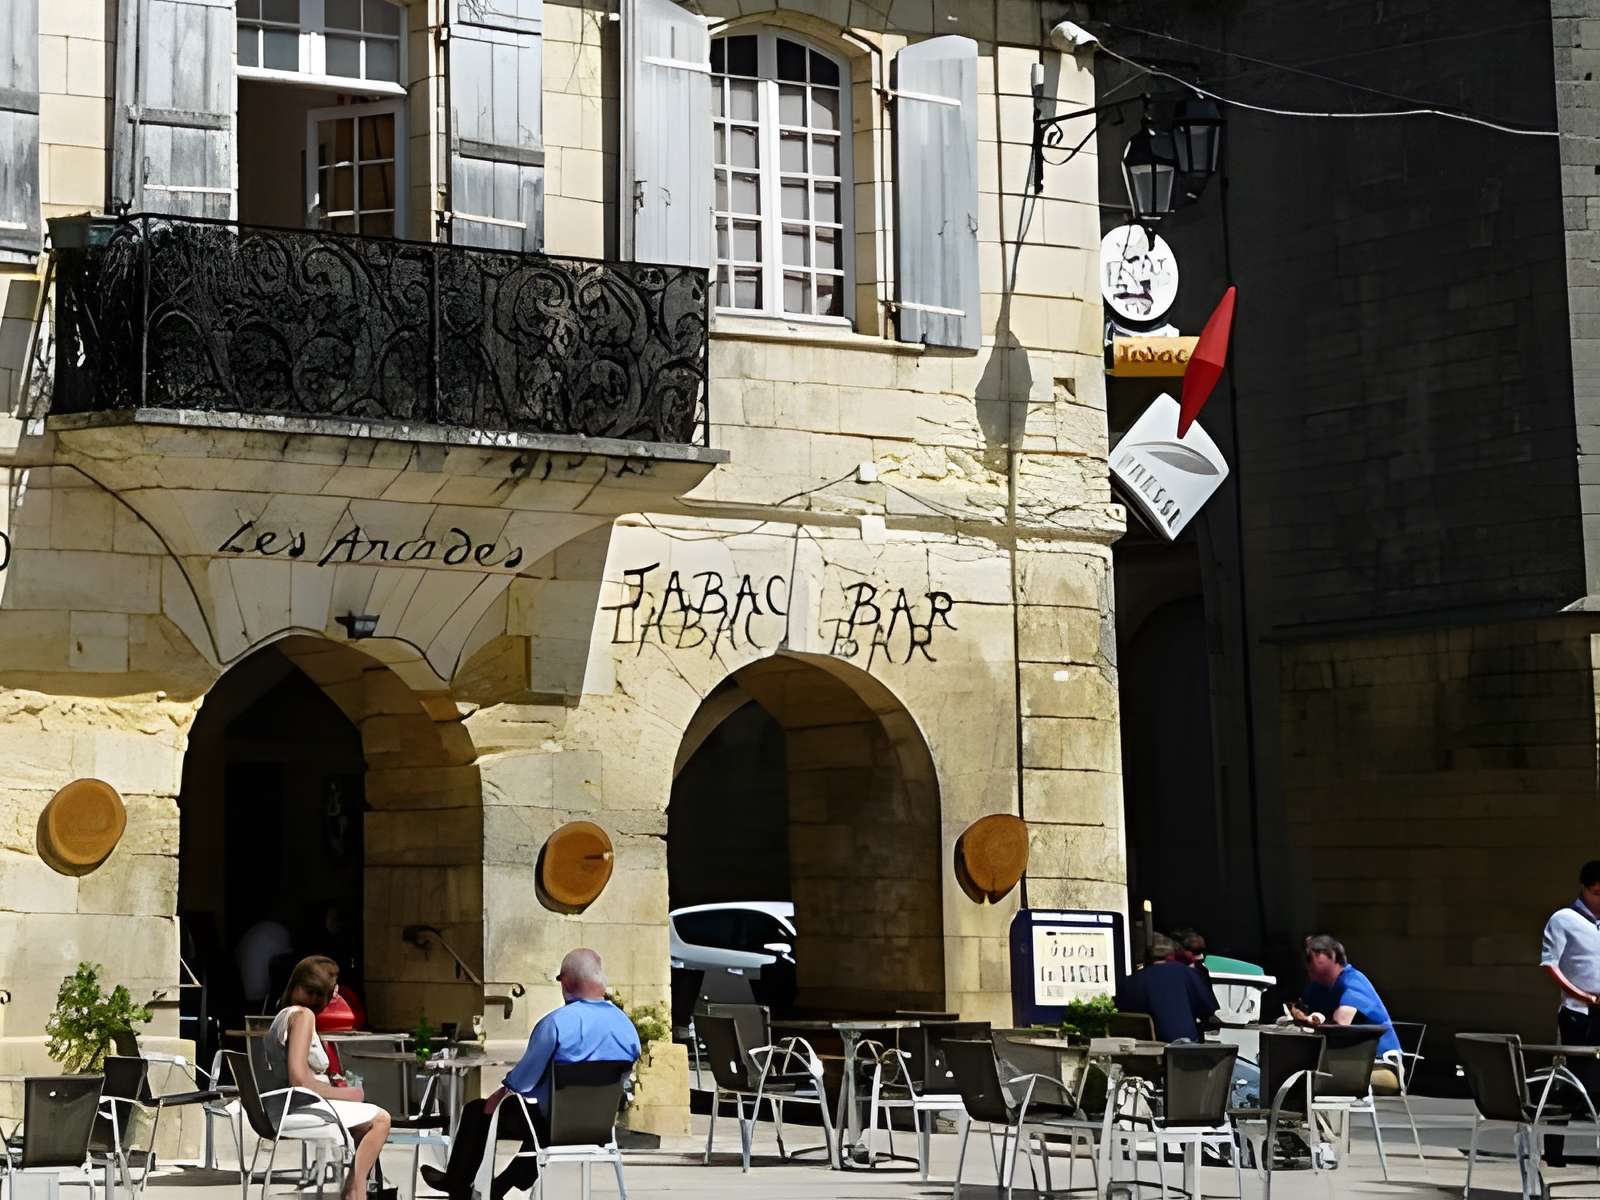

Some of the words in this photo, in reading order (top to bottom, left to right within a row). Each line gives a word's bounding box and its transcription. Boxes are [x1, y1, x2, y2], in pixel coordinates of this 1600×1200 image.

[218, 521, 306, 558] Les
[317, 525, 523, 568] Arcades
[608, 562, 787, 640] TABAC
[846, 582, 958, 639] BAR
